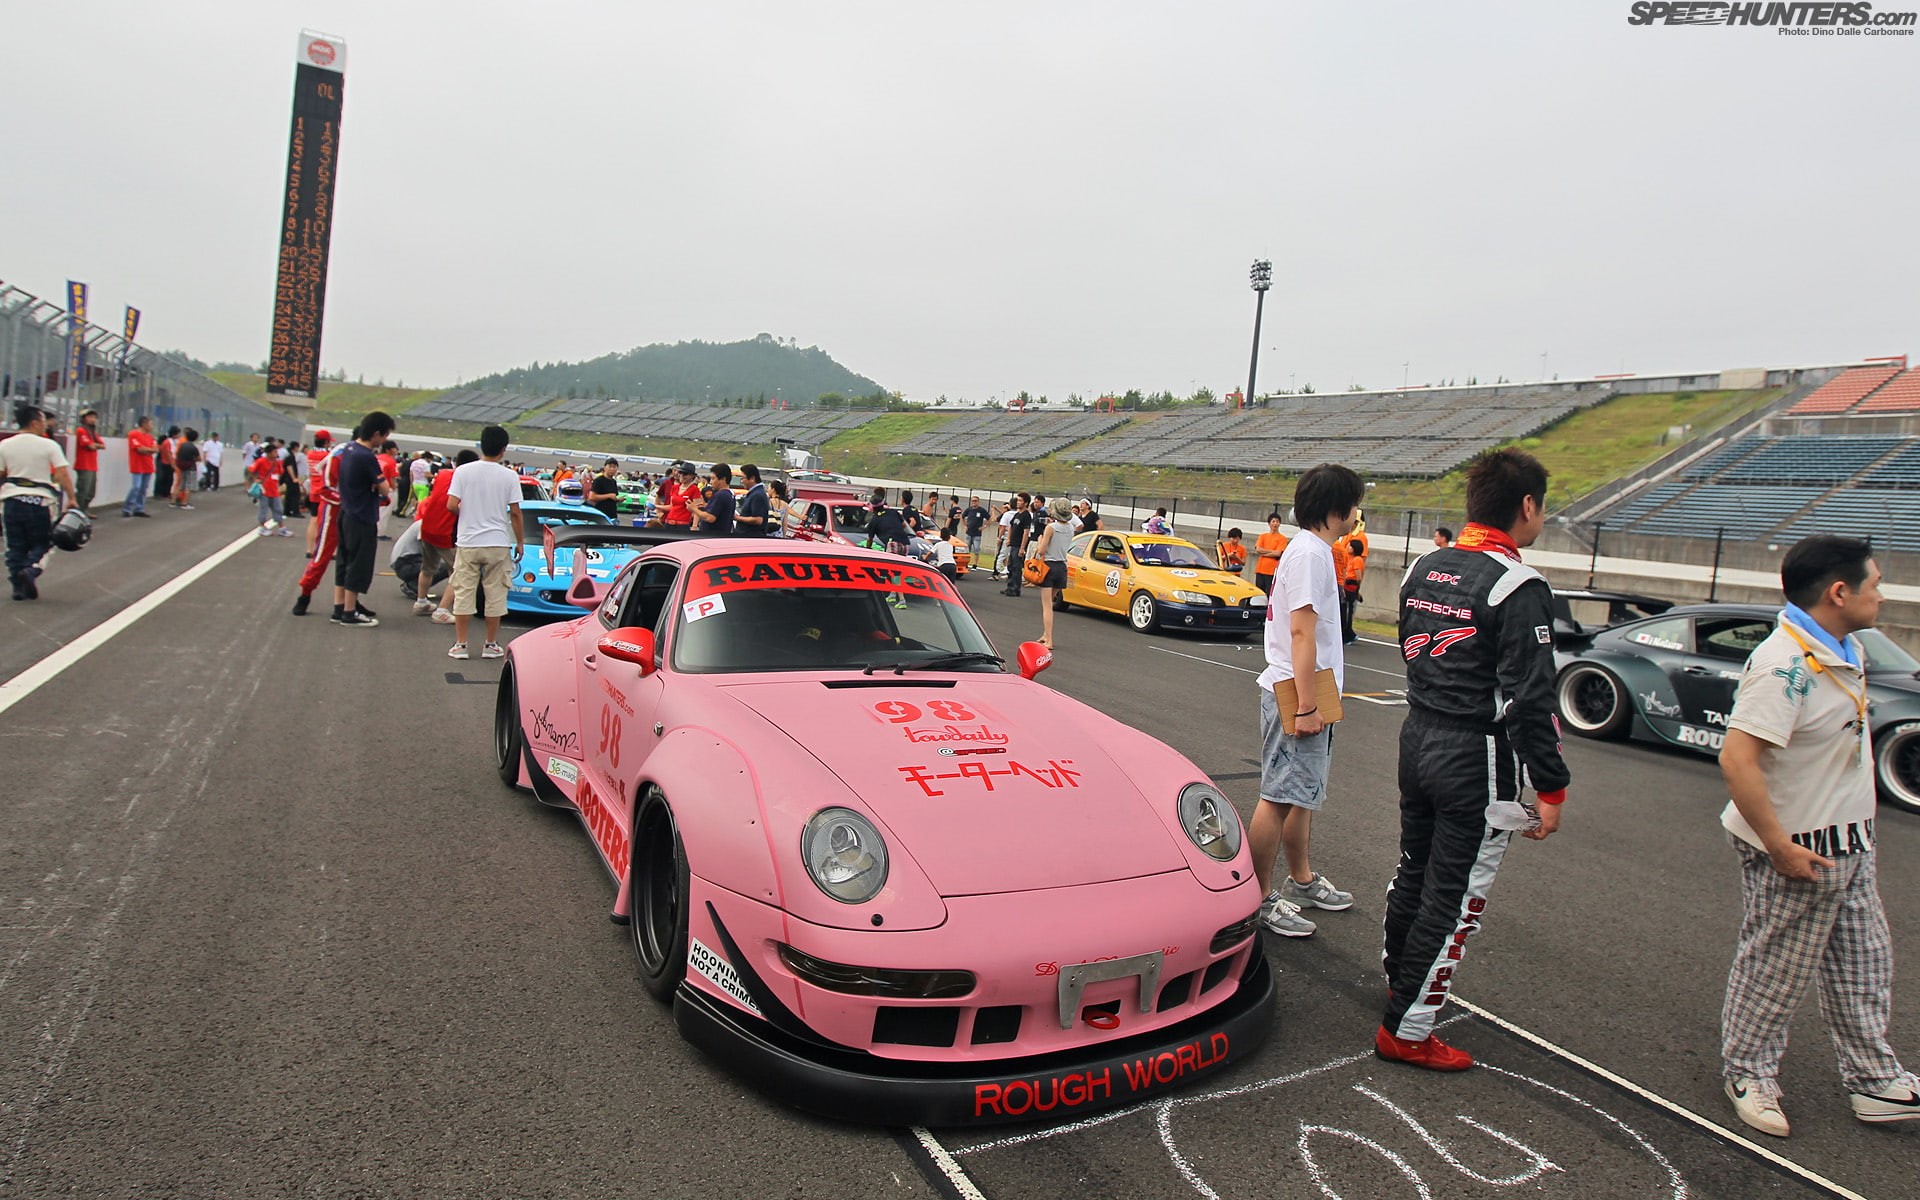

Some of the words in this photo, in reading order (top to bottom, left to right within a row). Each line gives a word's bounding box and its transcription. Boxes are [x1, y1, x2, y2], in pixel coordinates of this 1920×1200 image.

[704, 562, 951, 597] RAUH-Welt
[1106, 576, 1118, 589] 282
[698, 601, 714, 617] P
[1404, 626, 1477, 661] 27
[874, 700, 977, 723] 98
[600, 703, 622, 769] 98
[897, 759, 1082, 797] モーターヘッド
[691, 955, 712, 975] NOT
[712, 973, 719, 983] A
[693, 944, 745, 987] HOONIN
[975, 1067, 1112, 1117] ROUGH
[1122, 1031, 1229, 1092] WORLD
